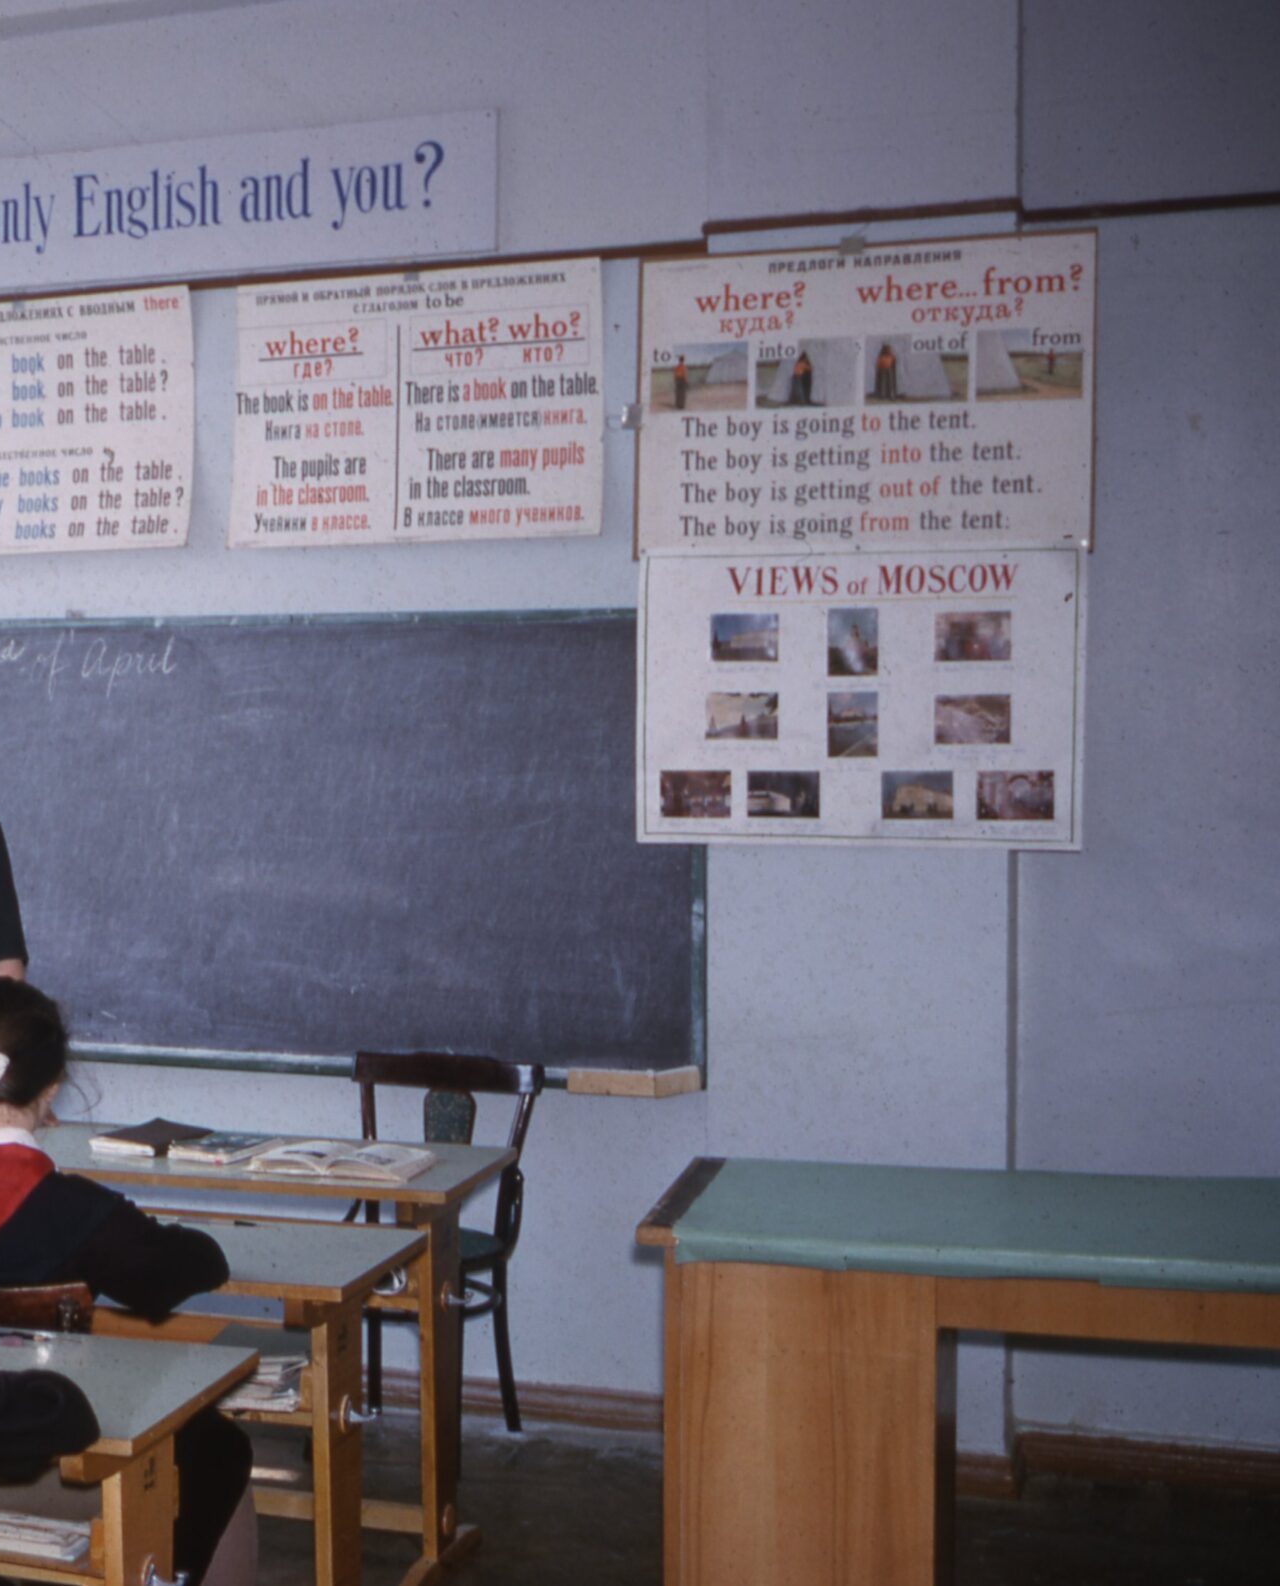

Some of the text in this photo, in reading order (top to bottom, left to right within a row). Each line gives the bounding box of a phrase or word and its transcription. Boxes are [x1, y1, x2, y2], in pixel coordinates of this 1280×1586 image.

[73, 165, 220, 239] English
[239, 158, 311, 222] and
[330, 141, 445, 230] you?
[768, 250, 963, 274] ПРЕДЛОГИ НАПРАВЛЕНИЯ
[982, 264, 1083, 297] from?
[696, 282, 805, 313] where?
[720, 310, 794, 338] куда?
[911, 297, 1024, 326] откуда?
[421, 311, 580, 346] what? who?
[913, 332, 969, 351] out of
[1032, 330, 1082, 346] from
[266, 328, 358, 357] where?
[523, 345, 563, 363] кто?
[653, 348, 671, 363] to
[759, 343, 796, 359] into
[293, 358, 332, 379] где?
[445, 348, 483, 367] что?
[12, 380, 46, 401] book
[58, 379, 74, 397] on
[85, 375, 108, 396] the
[237, 385, 393, 414] The book is on the table.
[406, 372, 598, 405] There is a book on the table.
[12, 406, 44, 428] book
[57, 407, 74, 425] on
[85, 403, 108, 423] the
[415, 414, 431, 433] На
[437, 414, 474, 431] столе
[543, 409, 587, 426] книга.
[681, 411, 976, 441] The boy is going to the tent.
[265, 420, 301, 441] Книга
[305, 422, 319, 438] на
[274, 455, 366, 482] The pupils are
[427, 442, 585, 472] There are many pupils
[681, 441, 1021, 474] The boy is getting into the tent.
[257, 483, 369, 506] in the classroom.
[410, 476, 530, 500] in the classroom.
[681, 474, 1042, 508] The boy is getting out of the tent.
[18, 493, 58, 514] books
[71, 493, 87, 511] on
[98, 489, 122, 510] the
[254, 513, 306, 534] Ученики
[311, 516, 318, 530] в
[403, 505, 584, 528] В классе много учеников.
[728, 564, 1019, 597] VIEWS of MOSCOW
[81, 636, 177, 698] April
